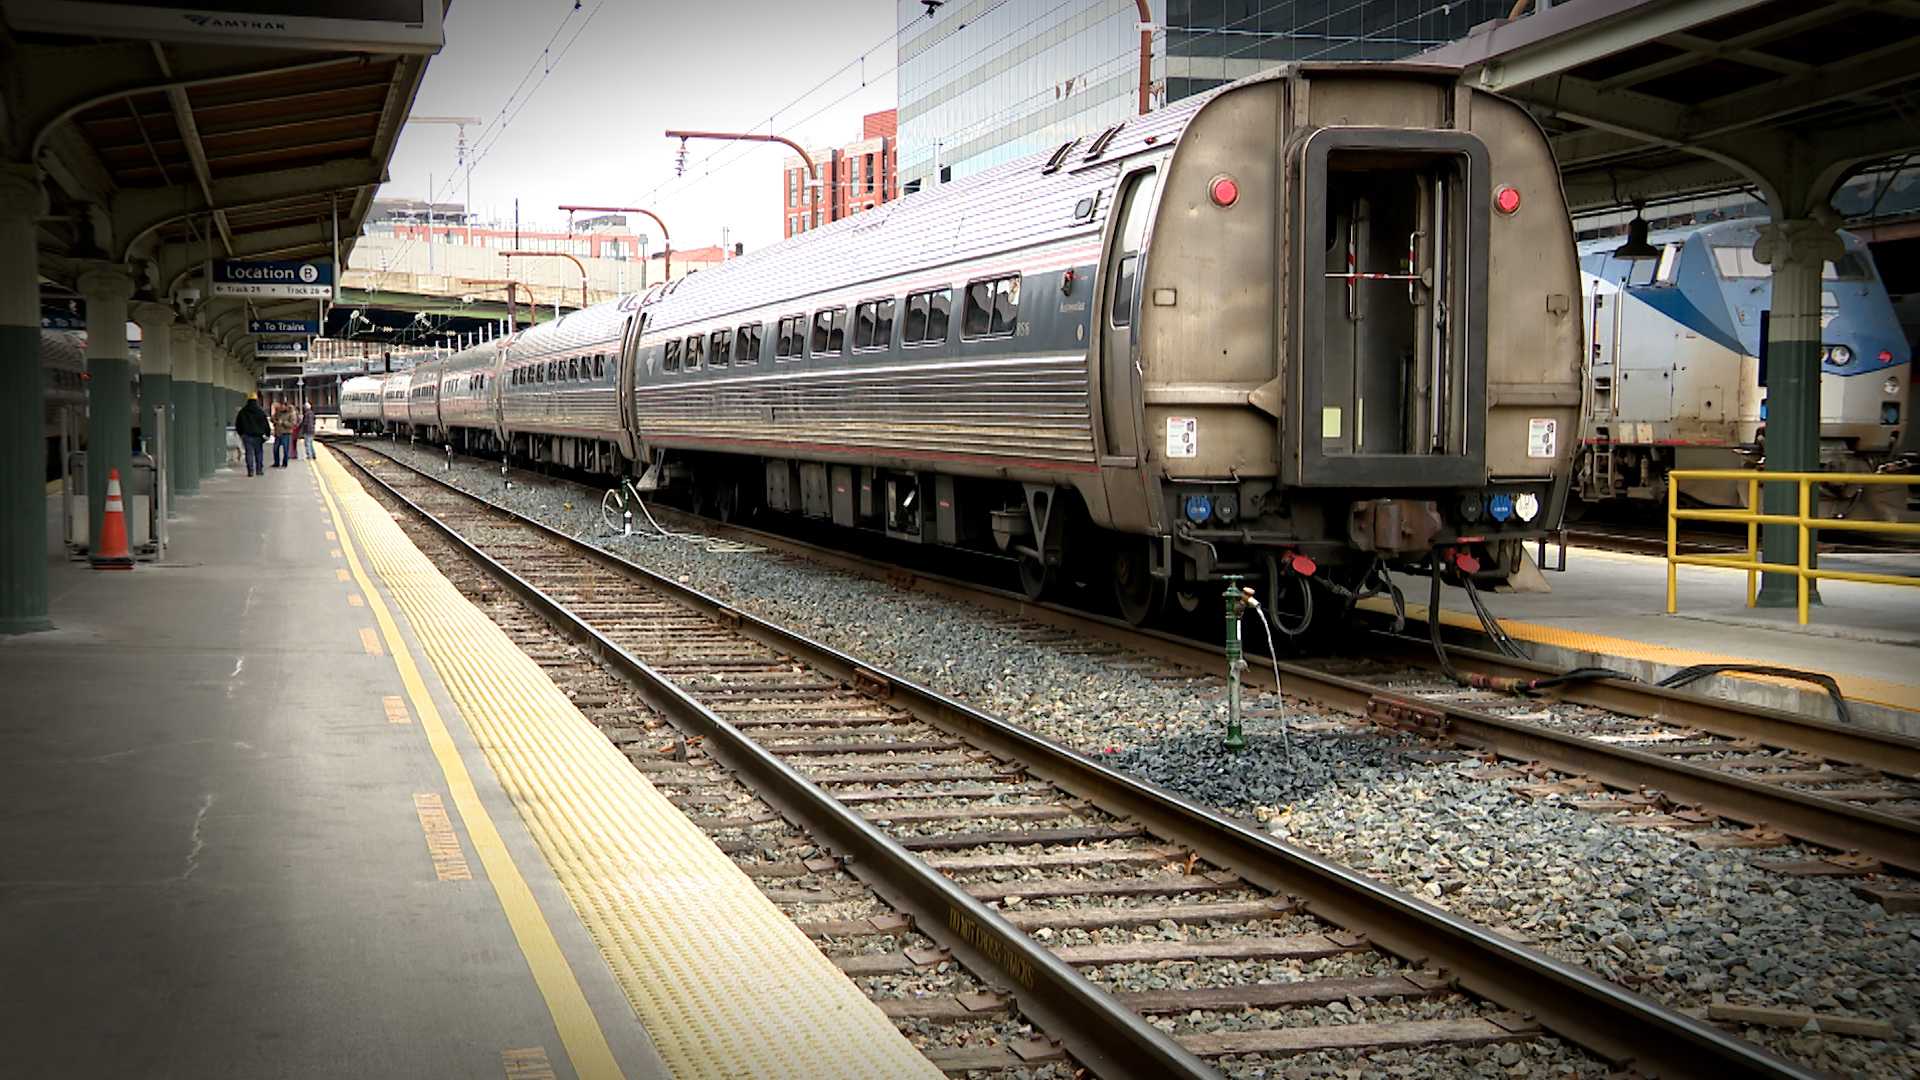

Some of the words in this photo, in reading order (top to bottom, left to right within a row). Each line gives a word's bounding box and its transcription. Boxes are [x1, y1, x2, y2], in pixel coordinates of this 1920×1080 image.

[212, 18, 286, 30] AMTRAK
[226, 265, 295, 279] Location
[287, 286, 307, 294] Track
[264, 322, 276, 330] To
[279, 321, 305, 331] Trains
